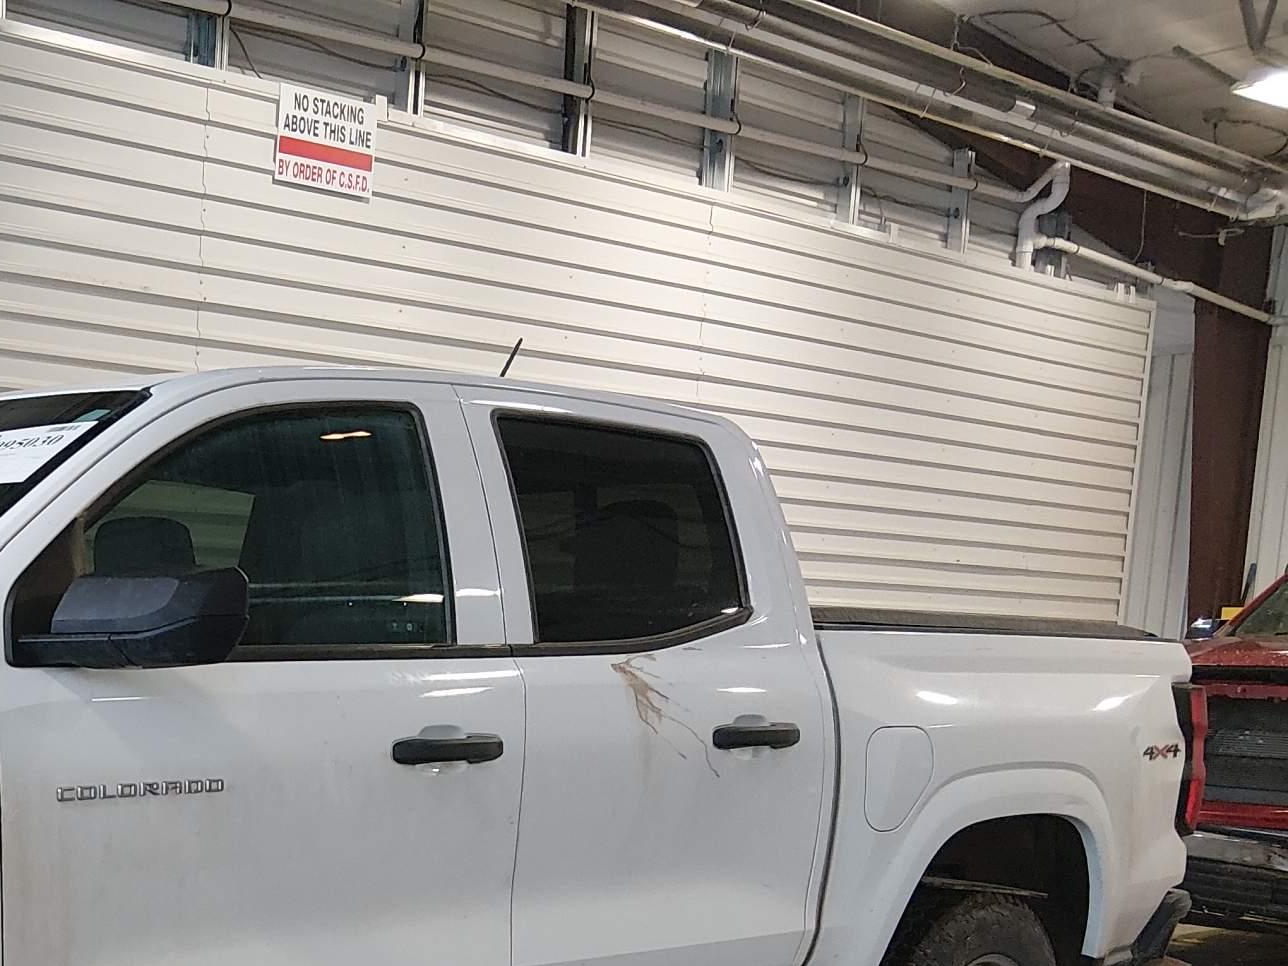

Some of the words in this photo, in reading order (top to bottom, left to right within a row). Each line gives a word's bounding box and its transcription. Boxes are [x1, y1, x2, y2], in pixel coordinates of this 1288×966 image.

[294, 92, 310, 113] NO
[312, 97, 365, 126] STACKING
[283, 113, 320, 138] ABOVE
[323, 121, 346, 144] THIS
[349, 128, 372, 150] LINE
[278, 158, 290, 177] BY
[292, 162, 323, 184] ORDER
[325, 168, 337, 186] OF
[339, 170, 370, 193] C.S.F.D.
[56, 778, 225, 803] COLORADO
